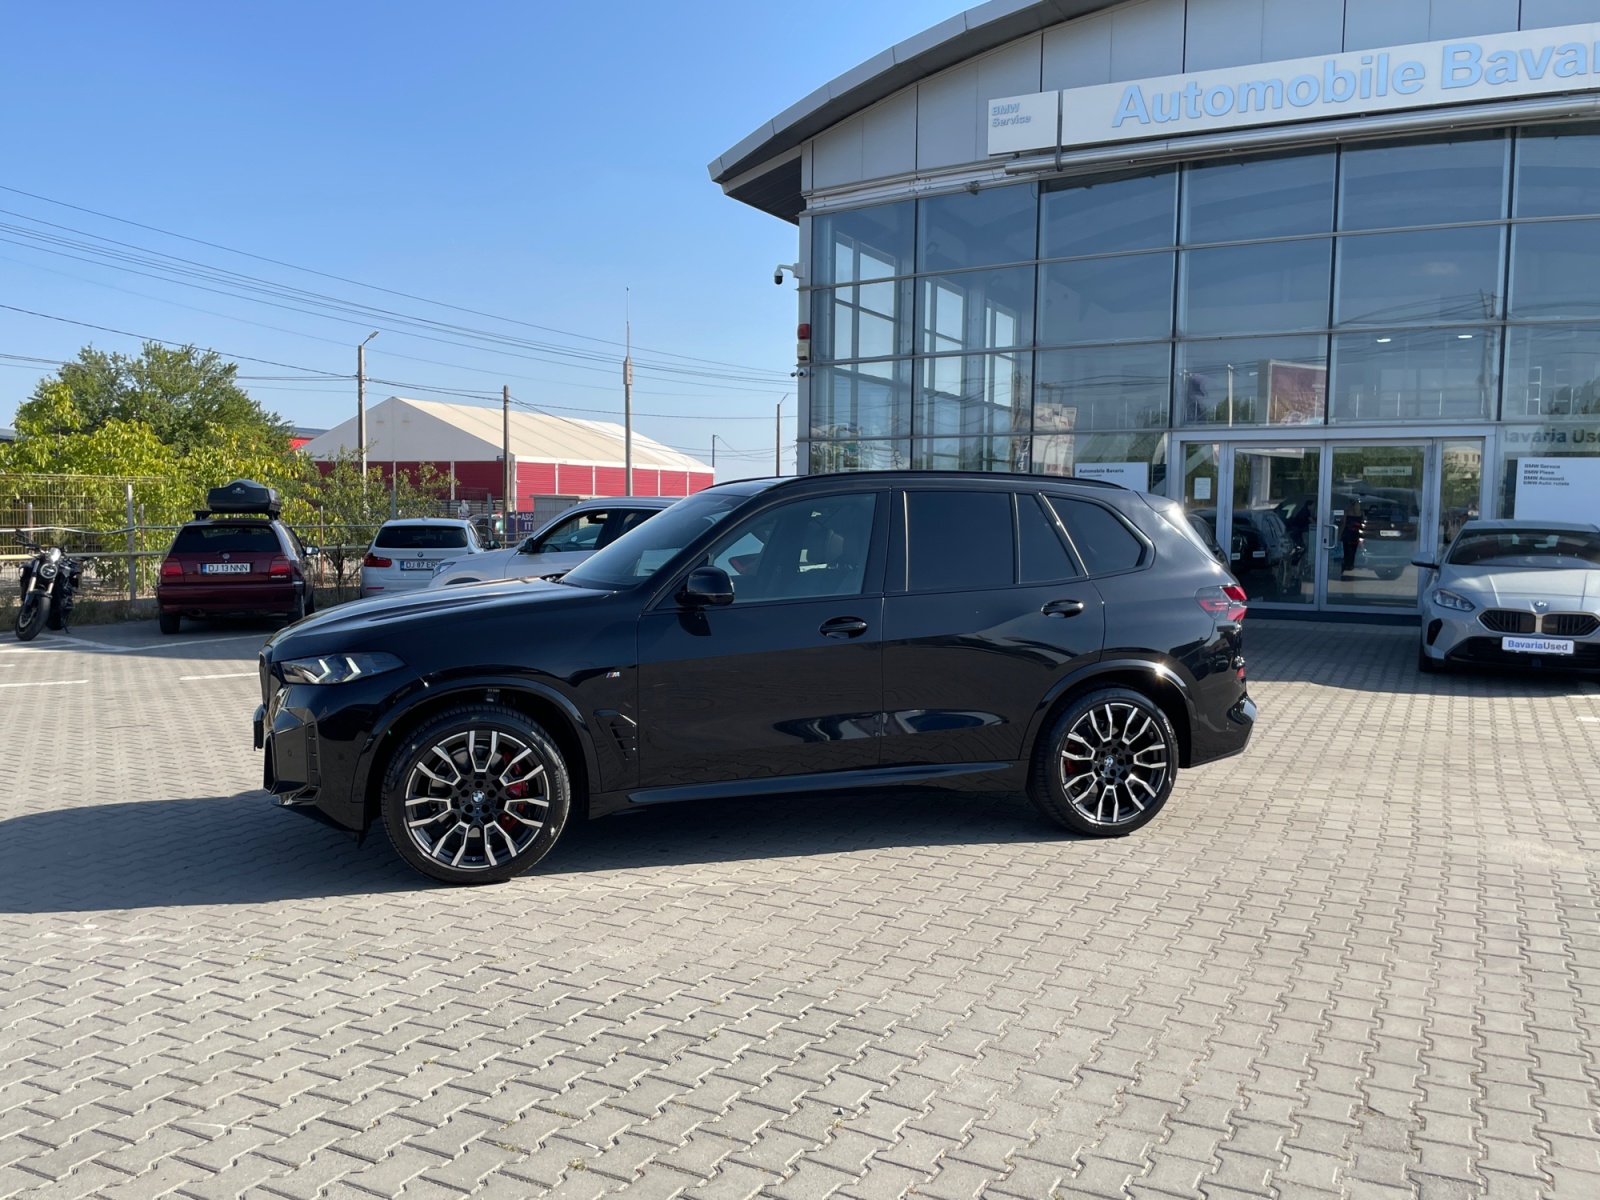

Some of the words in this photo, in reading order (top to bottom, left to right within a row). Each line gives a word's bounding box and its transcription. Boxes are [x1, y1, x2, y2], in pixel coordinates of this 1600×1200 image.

[1111, 52, 1426, 128] Automobile
[991, 102, 1020, 116] BMW
[991, 115, 1032, 128] Service
[1504, 428, 1567, 443] avaria
[1507, 639, 1568, 651] BavariaUsed
